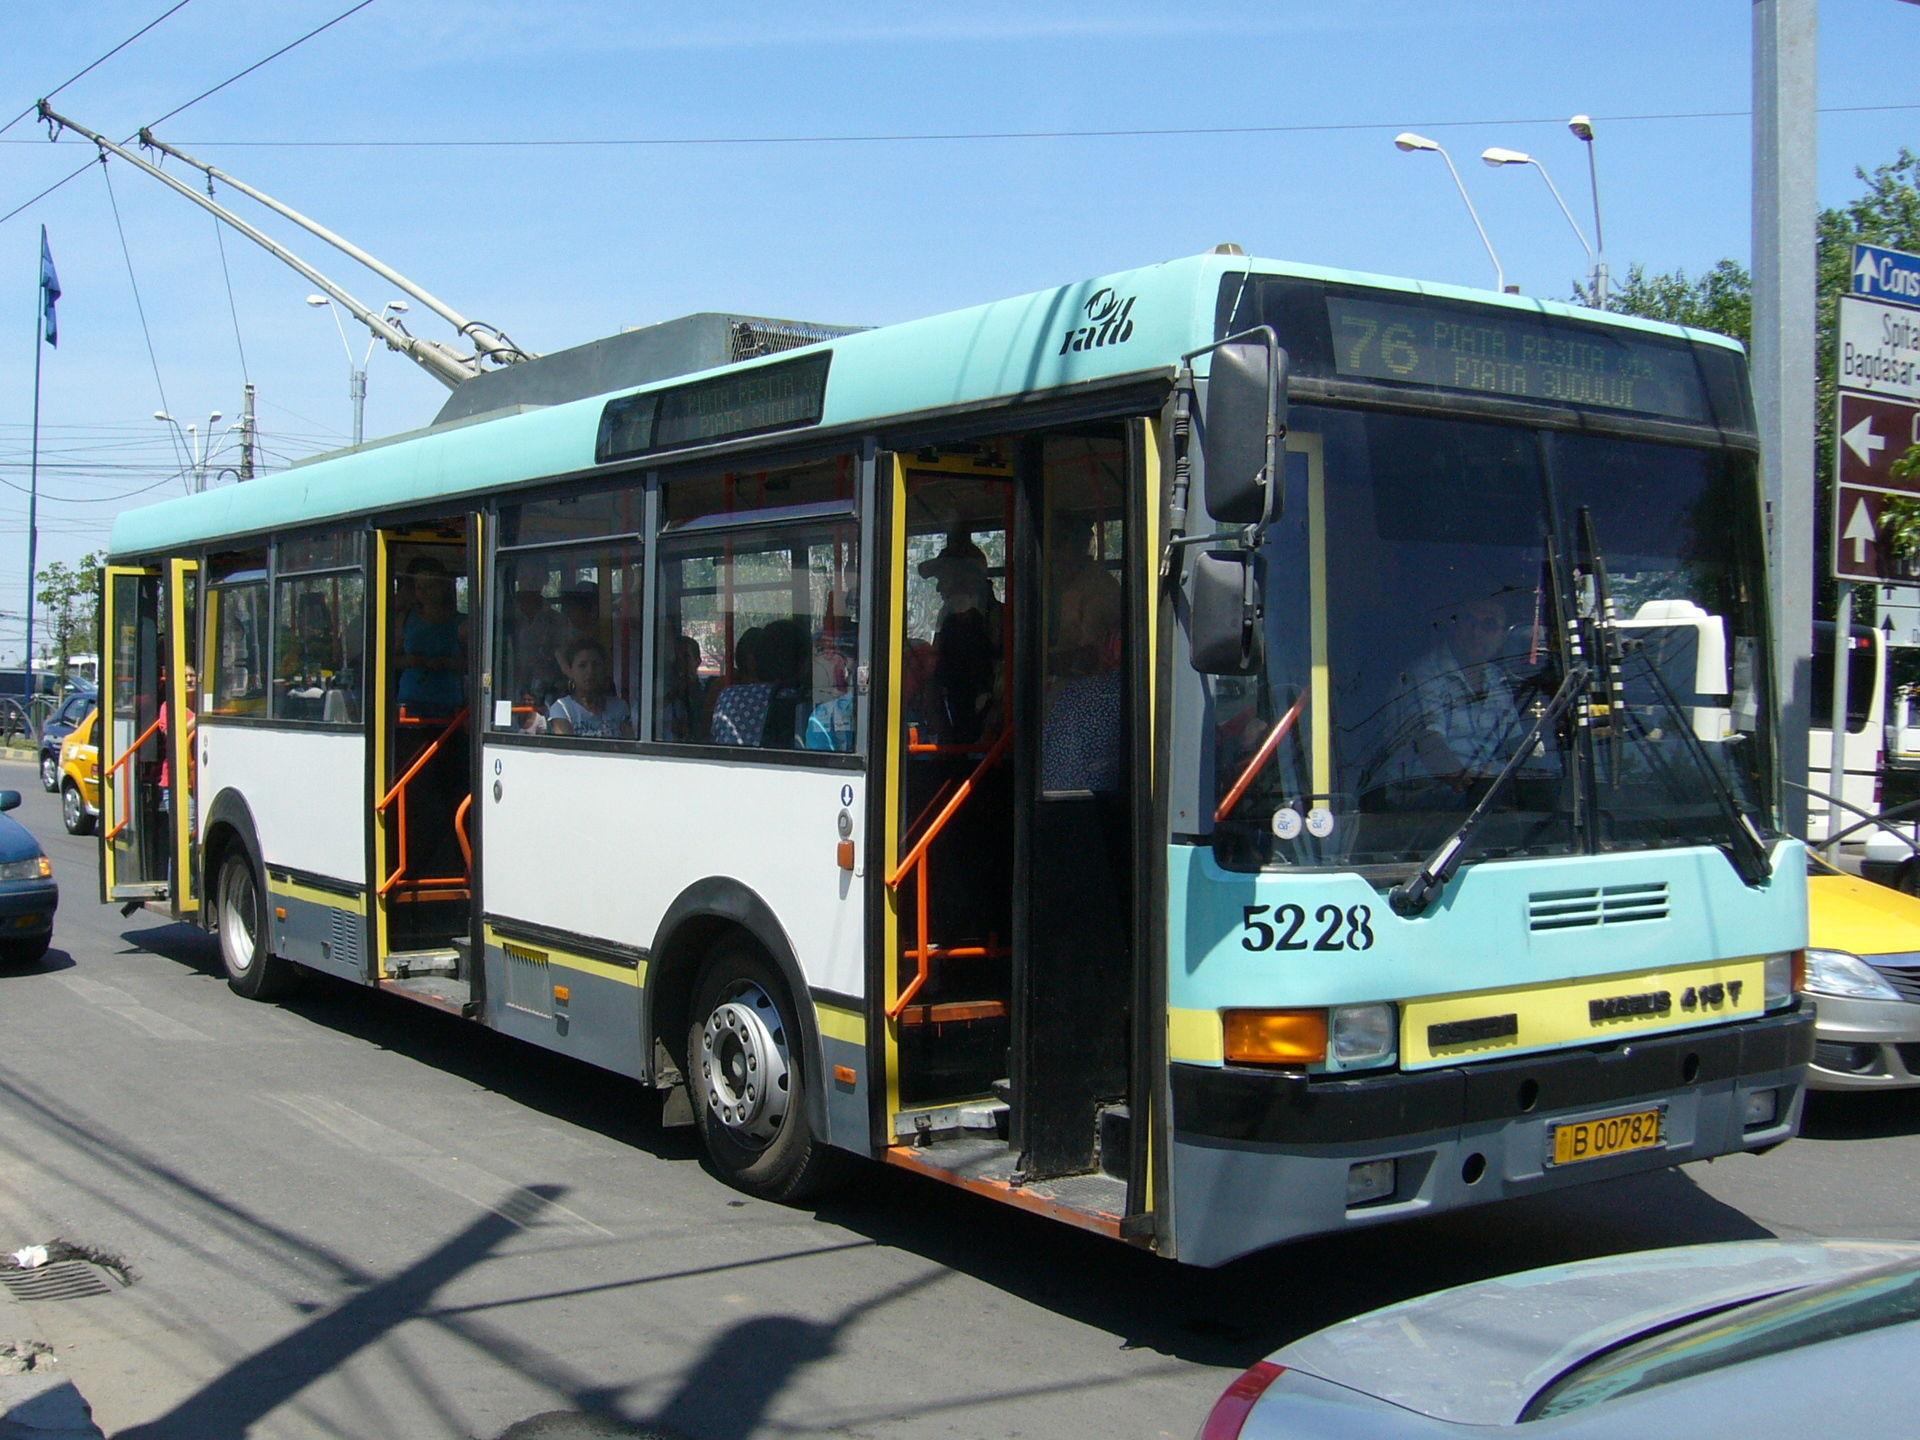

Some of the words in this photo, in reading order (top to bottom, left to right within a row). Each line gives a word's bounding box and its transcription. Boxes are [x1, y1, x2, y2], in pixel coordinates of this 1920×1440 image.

[1342, 315, 1419, 374] 76
[1455, 356, 1526, 395] PIATA
[1241, 903, 1374, 952] 5228
[1572, 1125, 1588, 1155] B
[1594, 1113, 1655, 1151] 00782
